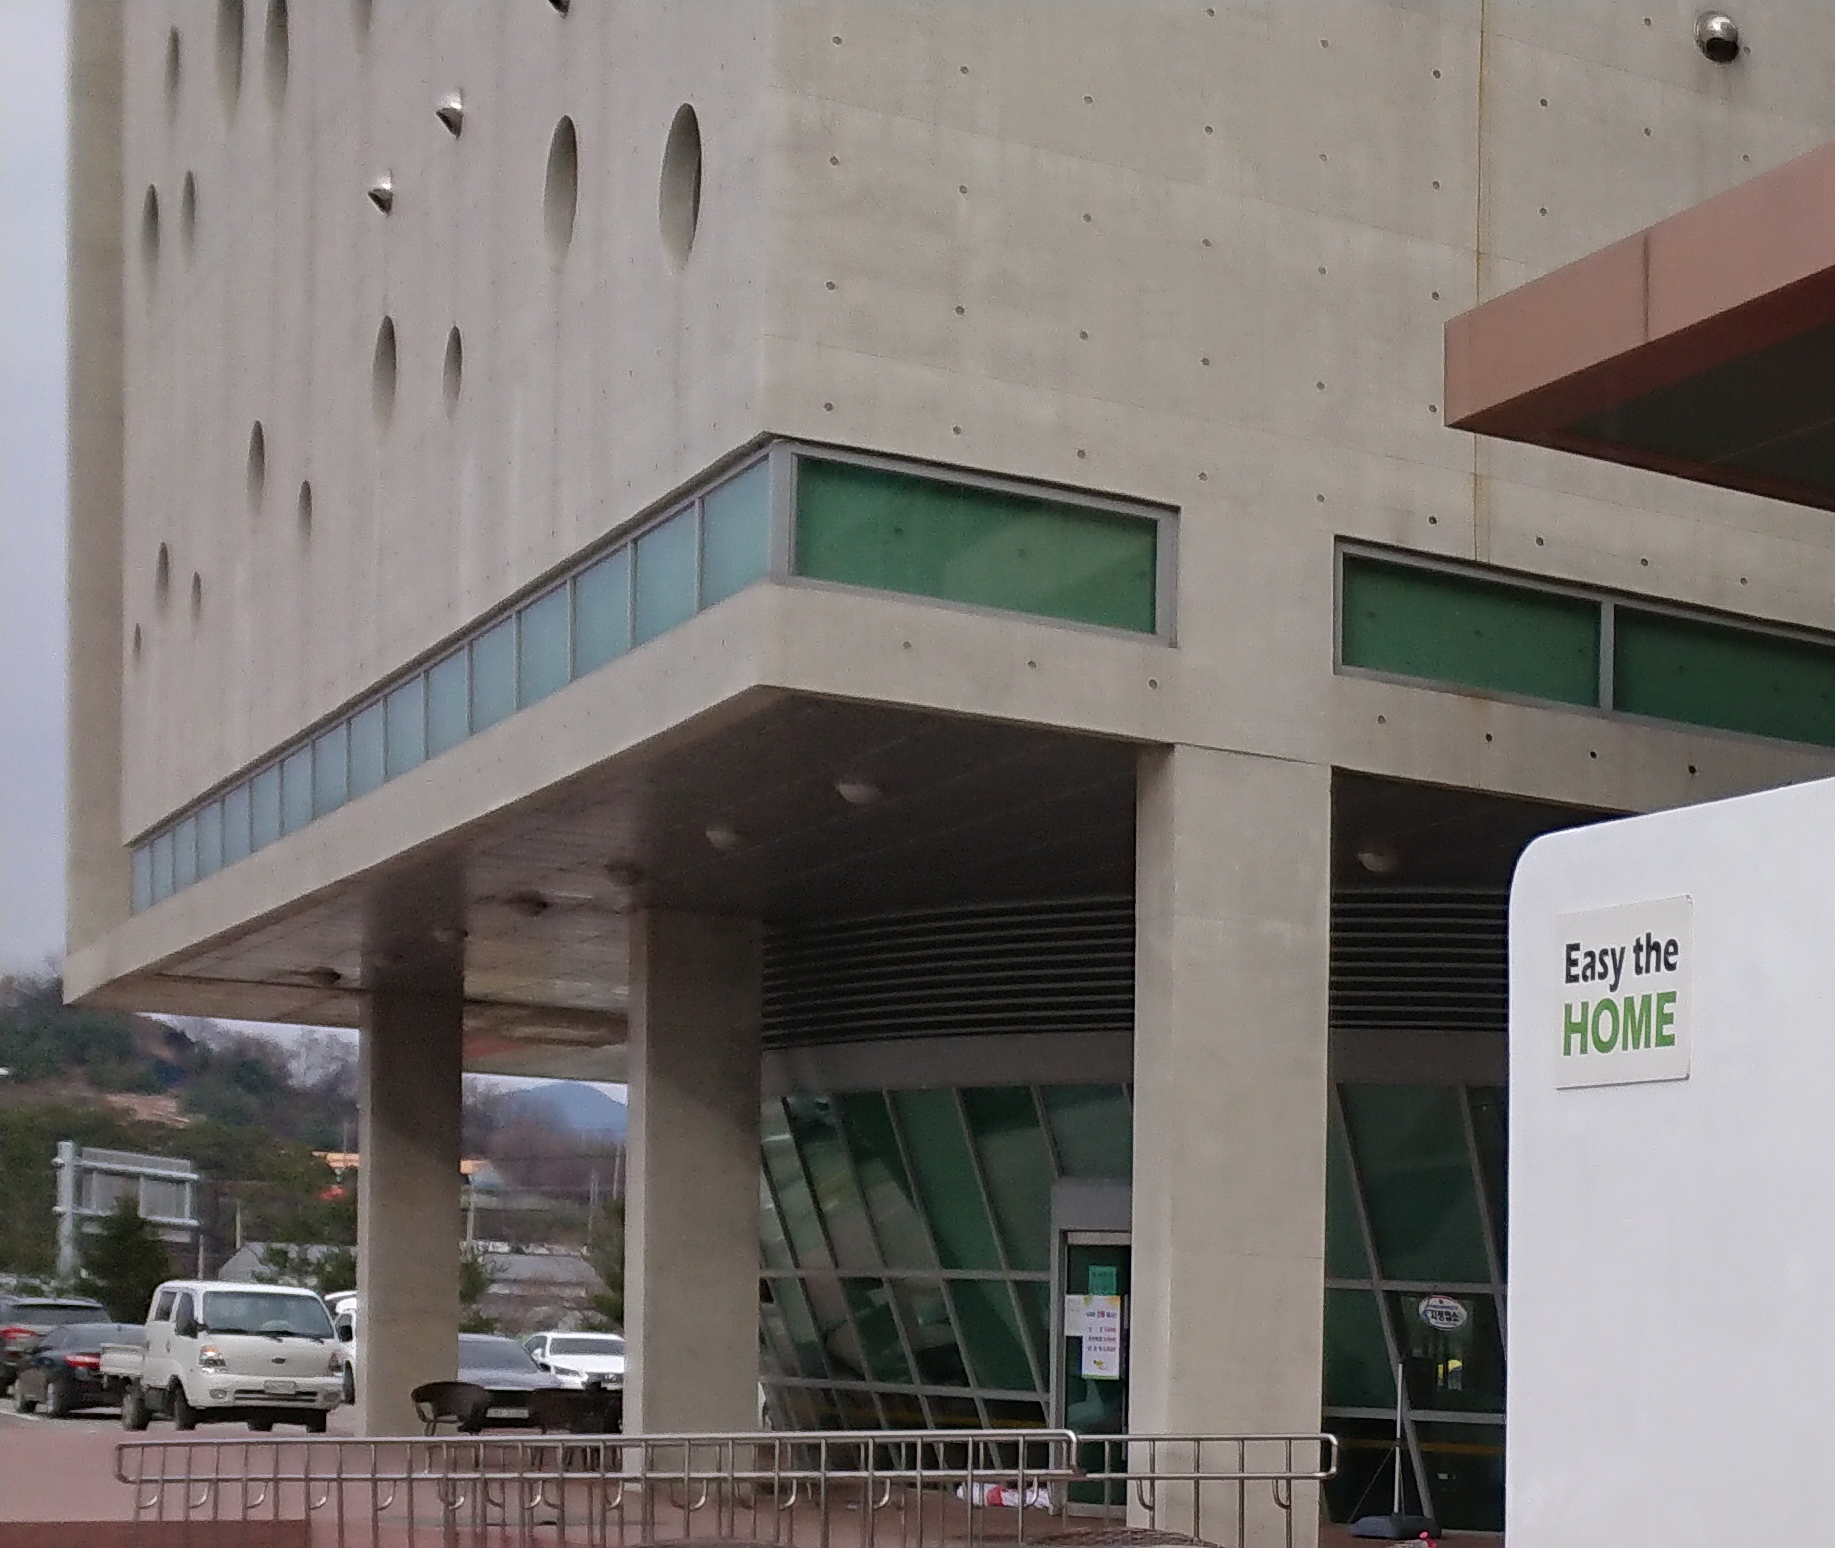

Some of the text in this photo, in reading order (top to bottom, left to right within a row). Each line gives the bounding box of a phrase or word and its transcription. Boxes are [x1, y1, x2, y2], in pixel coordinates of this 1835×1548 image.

[1564, 931, 1680, 993] Easy the
[1562, 990, 1678, 1057] HOME
